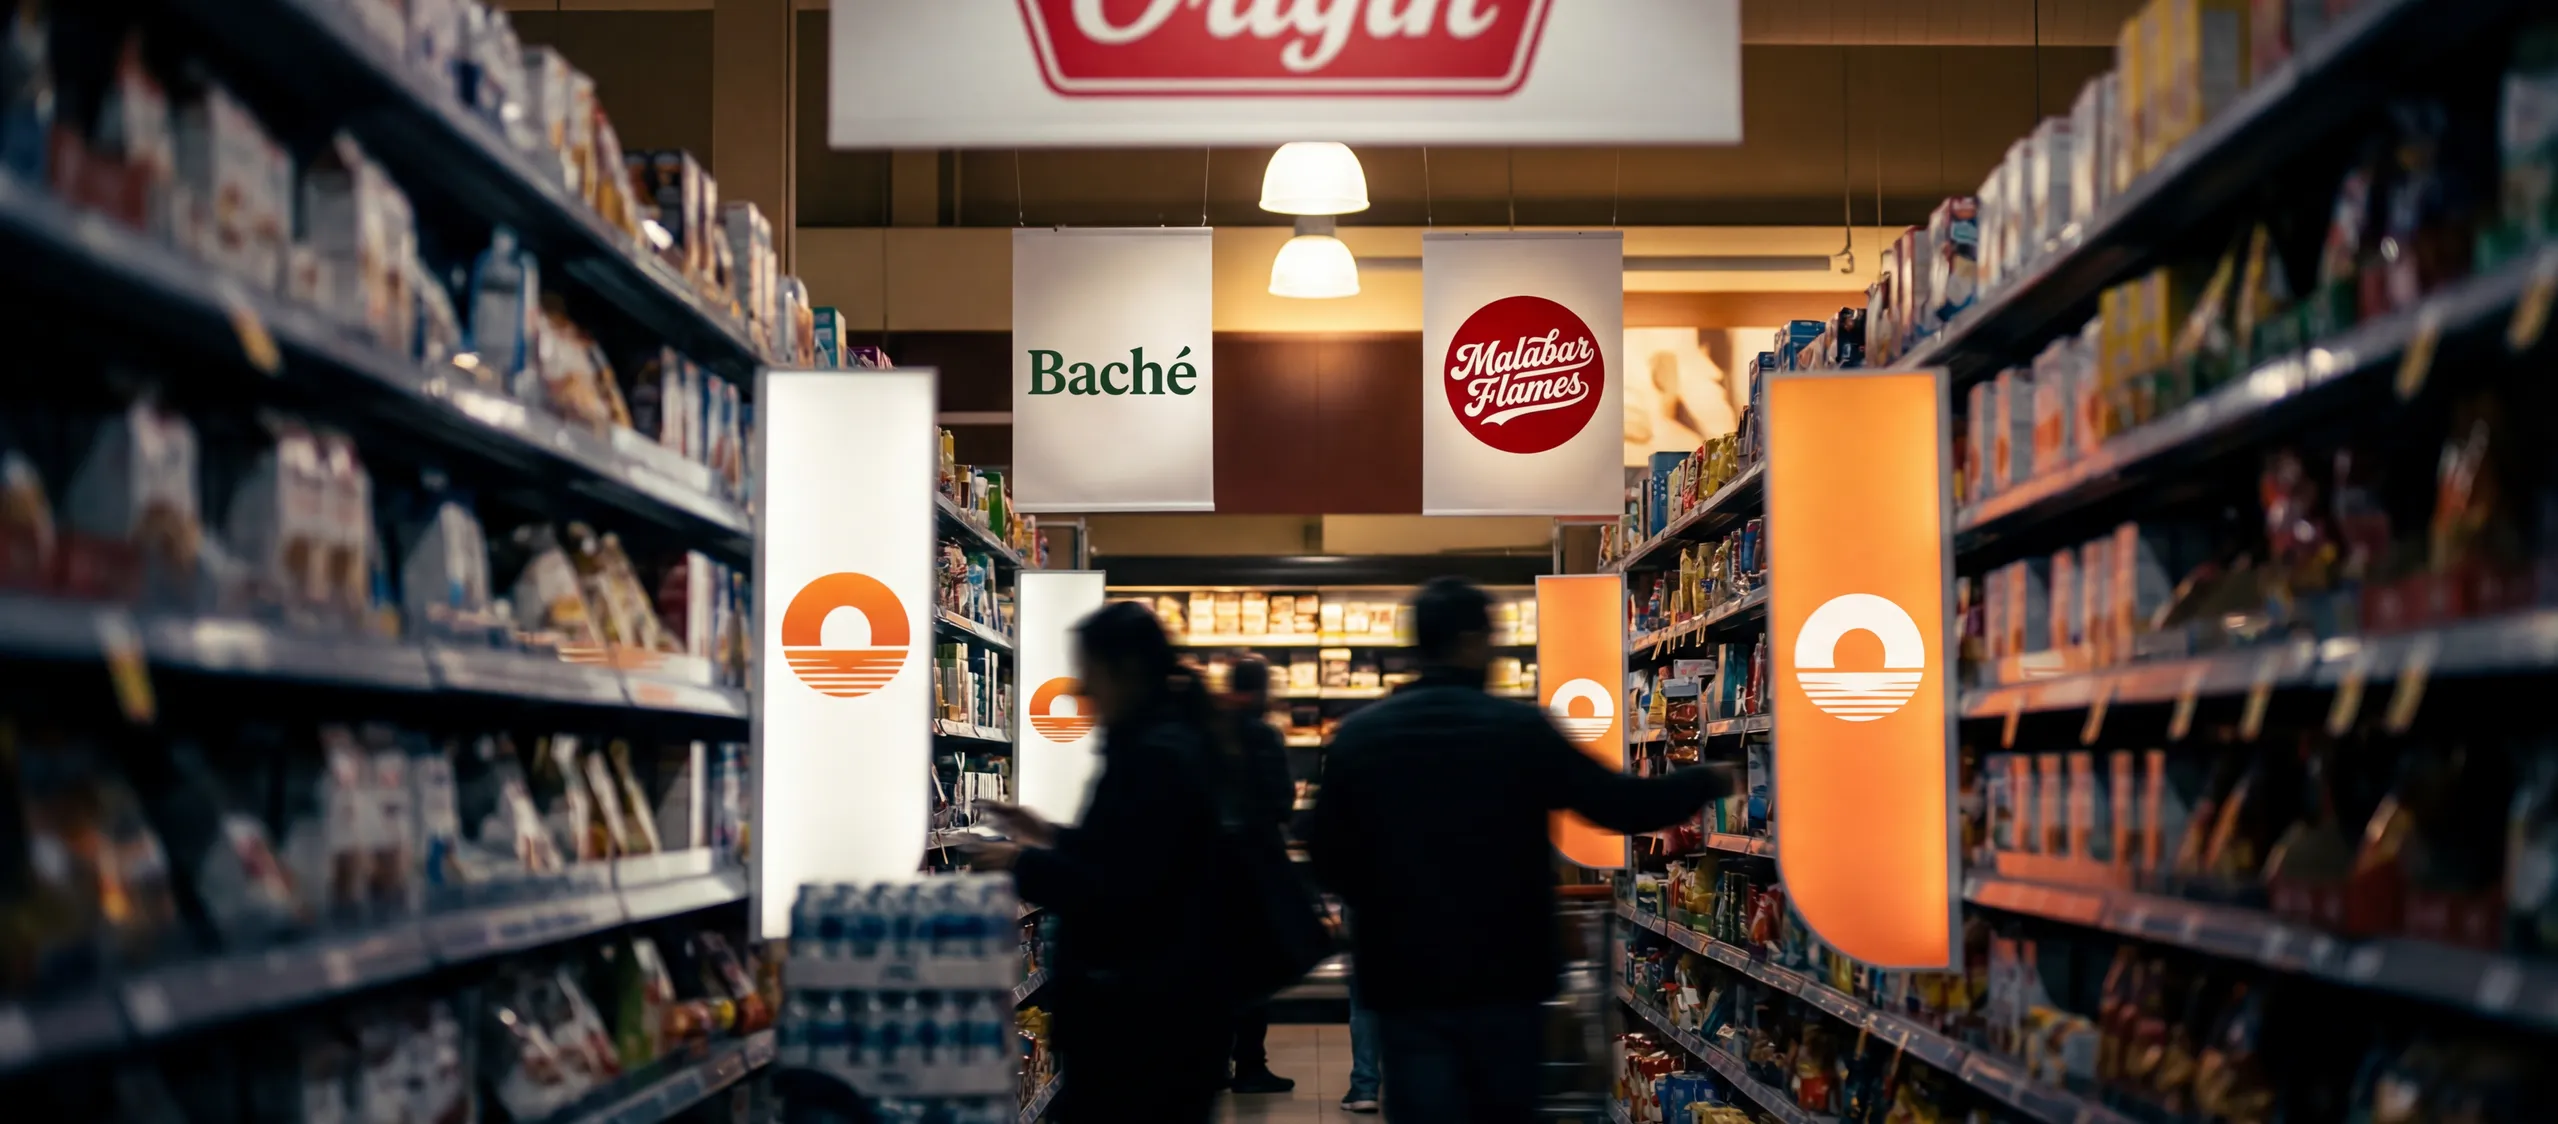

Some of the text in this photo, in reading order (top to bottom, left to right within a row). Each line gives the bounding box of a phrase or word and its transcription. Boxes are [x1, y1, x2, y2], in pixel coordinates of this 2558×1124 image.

[1027, 345, 1197, 396] Baché
[1450, 328, 1594, 380] Malabar
[1464, 372, 1589, 426] Flames
